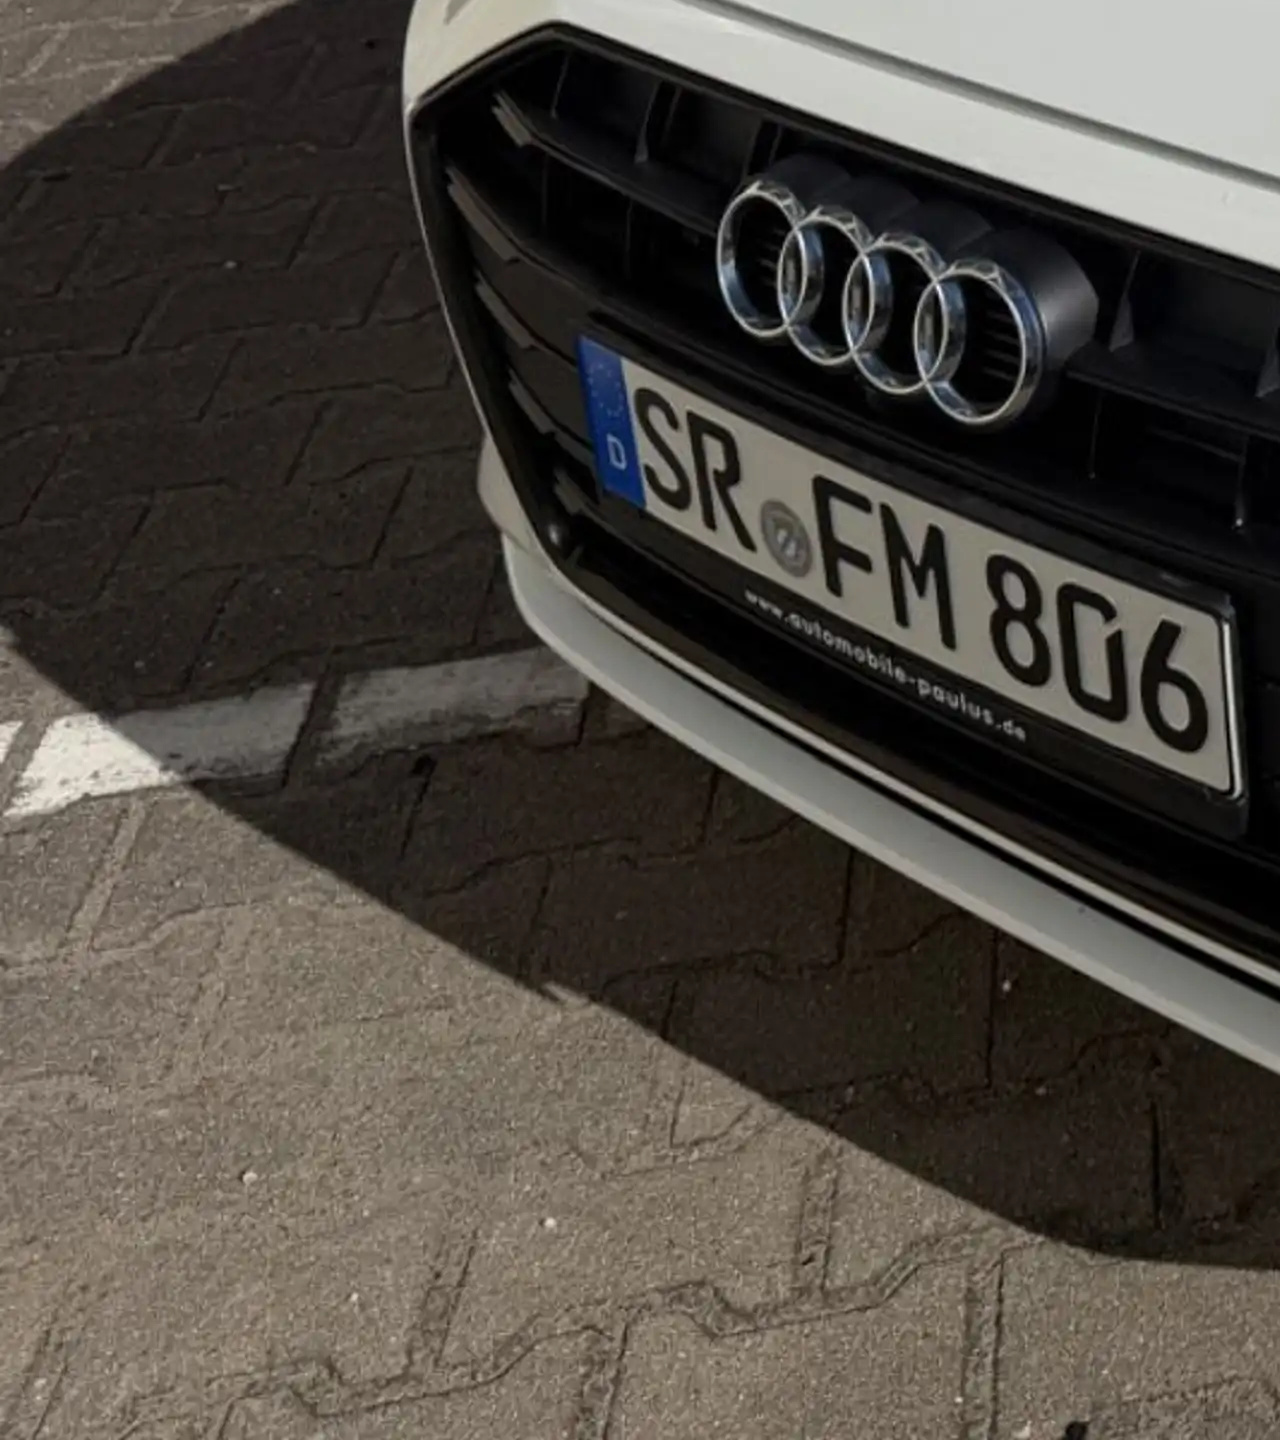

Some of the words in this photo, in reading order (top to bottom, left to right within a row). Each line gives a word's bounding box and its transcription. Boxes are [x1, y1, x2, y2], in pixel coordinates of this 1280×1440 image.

[606, 432, 628, 471] D
[634, 387, 757, 552] SR
[812, 474, 957, 651] FM
[986, 554, 1209, 753] 806
[744, 588, 1027, 743] www.automobile-paulus.de
